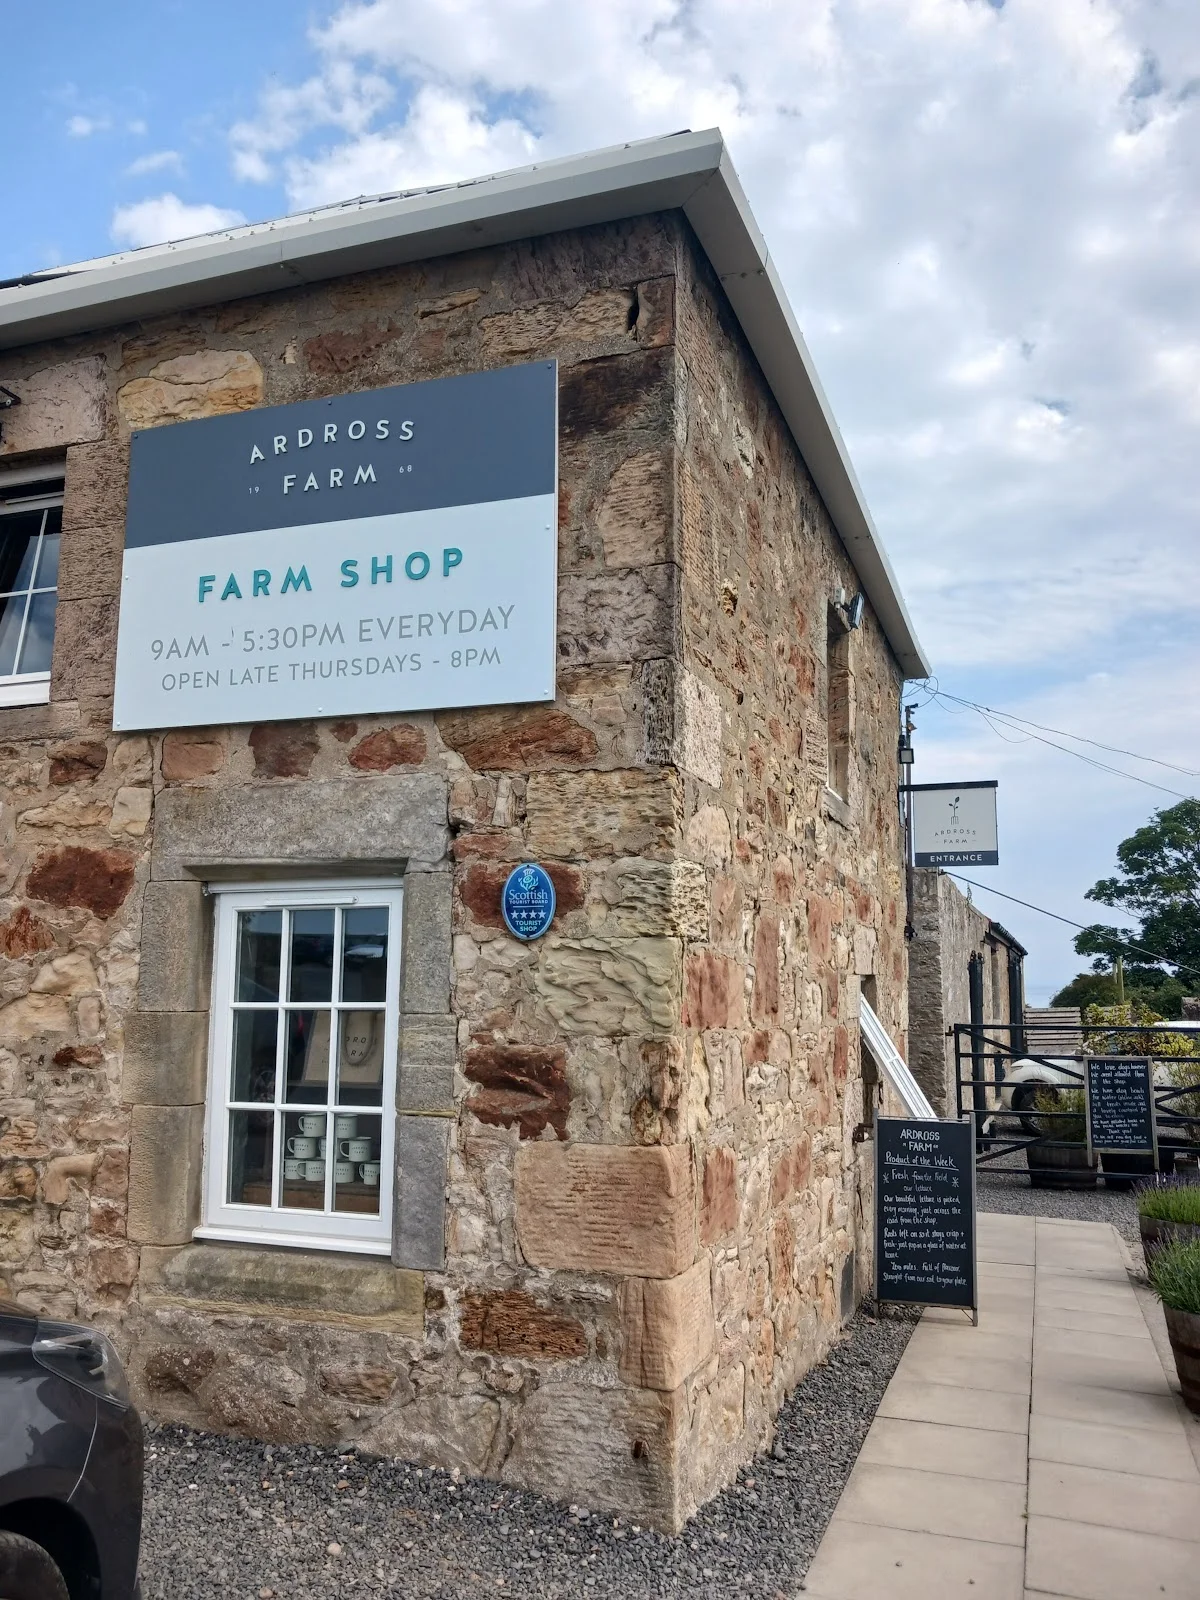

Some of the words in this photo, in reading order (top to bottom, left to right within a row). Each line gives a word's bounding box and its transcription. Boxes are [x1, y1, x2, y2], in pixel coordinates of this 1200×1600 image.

[249, 418, 416, 465] ARDROSS
[248, 485, 261, 495] 19
[282, 463, 378, 495] FARM
[399, 464, 413, 474] 68
[198, 564, 313, 602] FARM
[340, 547, 463, 588] SHOP
[150, 634, 210, 661] 9AM
[242, 621, 346, 653] 5:30PM
[358, 605, 516, 643] EVERYDAY
[161, 668, 220, 692] OPEN
[229, 664, 279, 686] LATE
[289, 653, 422, 681] THURSDAYS
[450, 647, 501, 669] 8PM
[934, 828, 976, 837] ARDROSS
[930, 854, 983, 862] ENTRANCE
[508, 889, 548, 900] Scottish
[1104, 1062, 1116, 1070] love
[1116, 1087, 1127, 1095] dog
[899, 1128, 940, 1141] ARDROSS
[908, 1141, 933, 1152] FARM
[885, 1151, 909, 1164] Product
[912, 1155, 919, 1165] of
[920, 1155, 931, 1166] the
[934, 1154, 956, 1167] Week
[891, 1168, 909, 1180] Fresh
[915, 1184, 932, 1192] lettuce
[883, 1194, 894, 1202] Our
[895, 1195, 916, 1204] beautiful
[943, 1195, 960, 1205] picked
[883, 1206, 896, 1217] every
[920, 1206, 932, 1217] just
[951, 1206, 961, 1214] the
[900, 1216, 912, 1226] from
[883, 1227, 897, 1238] Roots
[899, 1228, 909, 1239] left
[931, 1229, 945, 1241] stays
[946, 1229, 959, 1240] crisp
[927, 1241, 938, 1252] glass
[939, 1241, 944, 1250] of
[922, 1262, 933, 1271] Full
[934, 1262, 940, 1272] of
[883, 1272, 903, 1284] Straight
[904, 1273, 916, 1282] from
[942, 1277, 954, 1288] your
